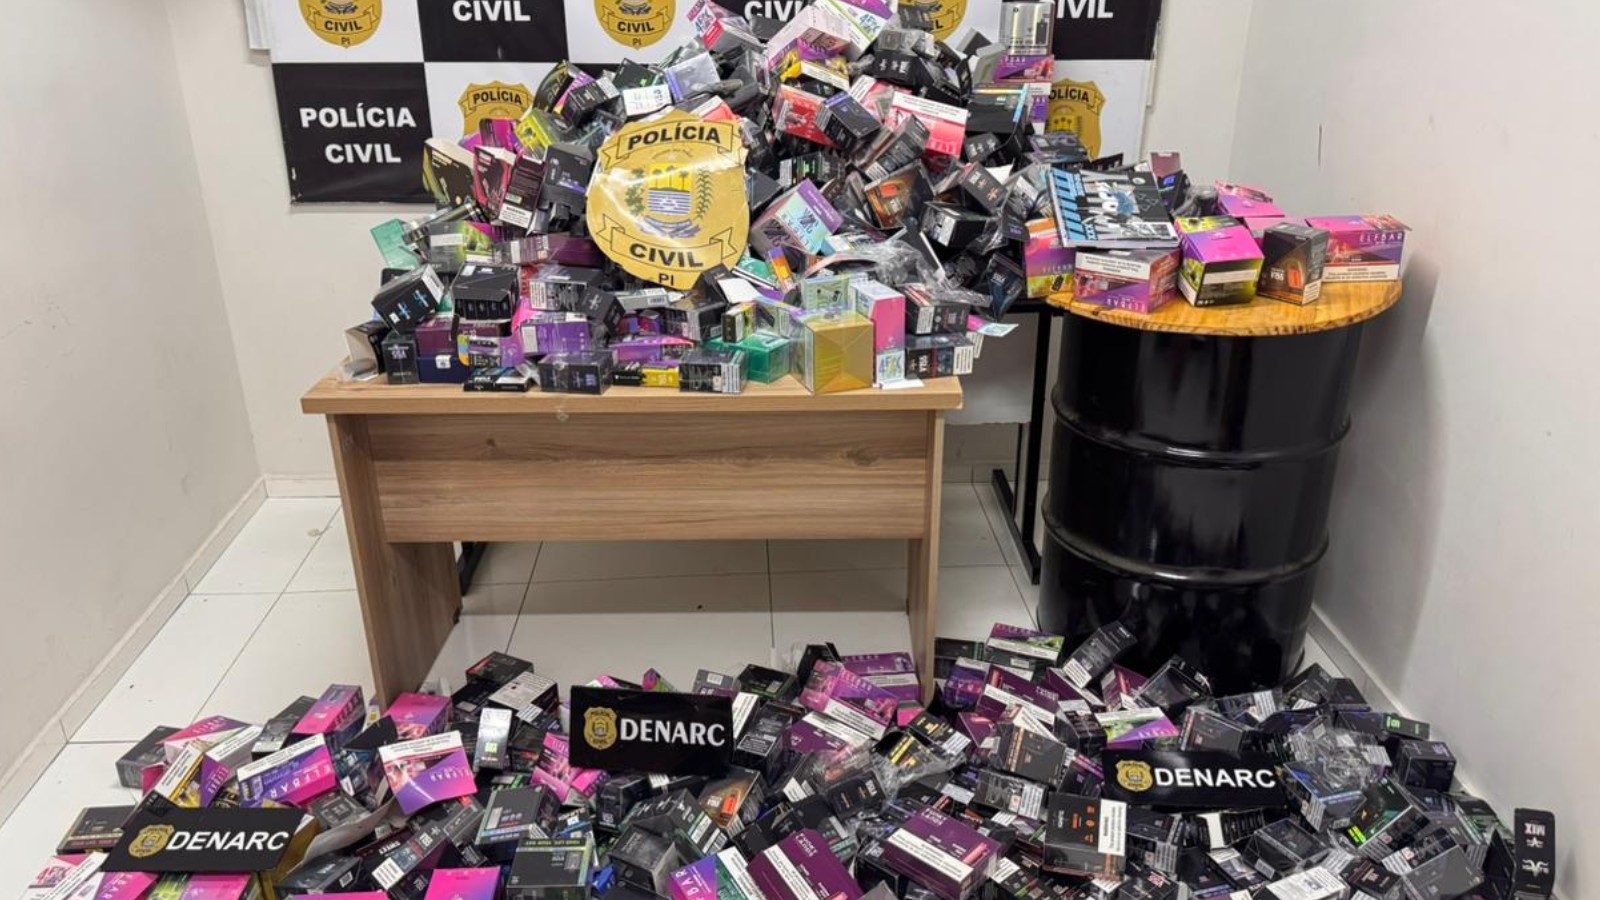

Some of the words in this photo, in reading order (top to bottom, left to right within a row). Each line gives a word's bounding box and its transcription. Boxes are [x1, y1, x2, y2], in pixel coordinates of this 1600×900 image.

[452, 0, 532, 22] CIVIL
[1057, 0, 1114, 20] IVIL
[323, 20, 364, 33] CIVIL
[616, 21, 656, 34] CIVIL
[341, 36, 352, 46] PI
[632, 37, 643, 47] PI
[472, 86, 523, 106] POLÍCIA
[1047, 85, 1090, 104] OLÍCIA
[299, 102, 417, 128] POLÍCIA
[626, 118, 722, 151] POLÍCIA
[324, 143, 402, 165] CIVIL
[1359, 232, 1403, 244] ELFBAR
[628, 242, 705, 269] CIVIL
[657, 272, 675, 286] PI
[620, 717, 726, 747] DENARC
[1154, 767, 1277, 789] DENARC
[1524, 822, 1547, 837] MIX
[165, 831, 291, 851] DENARC
